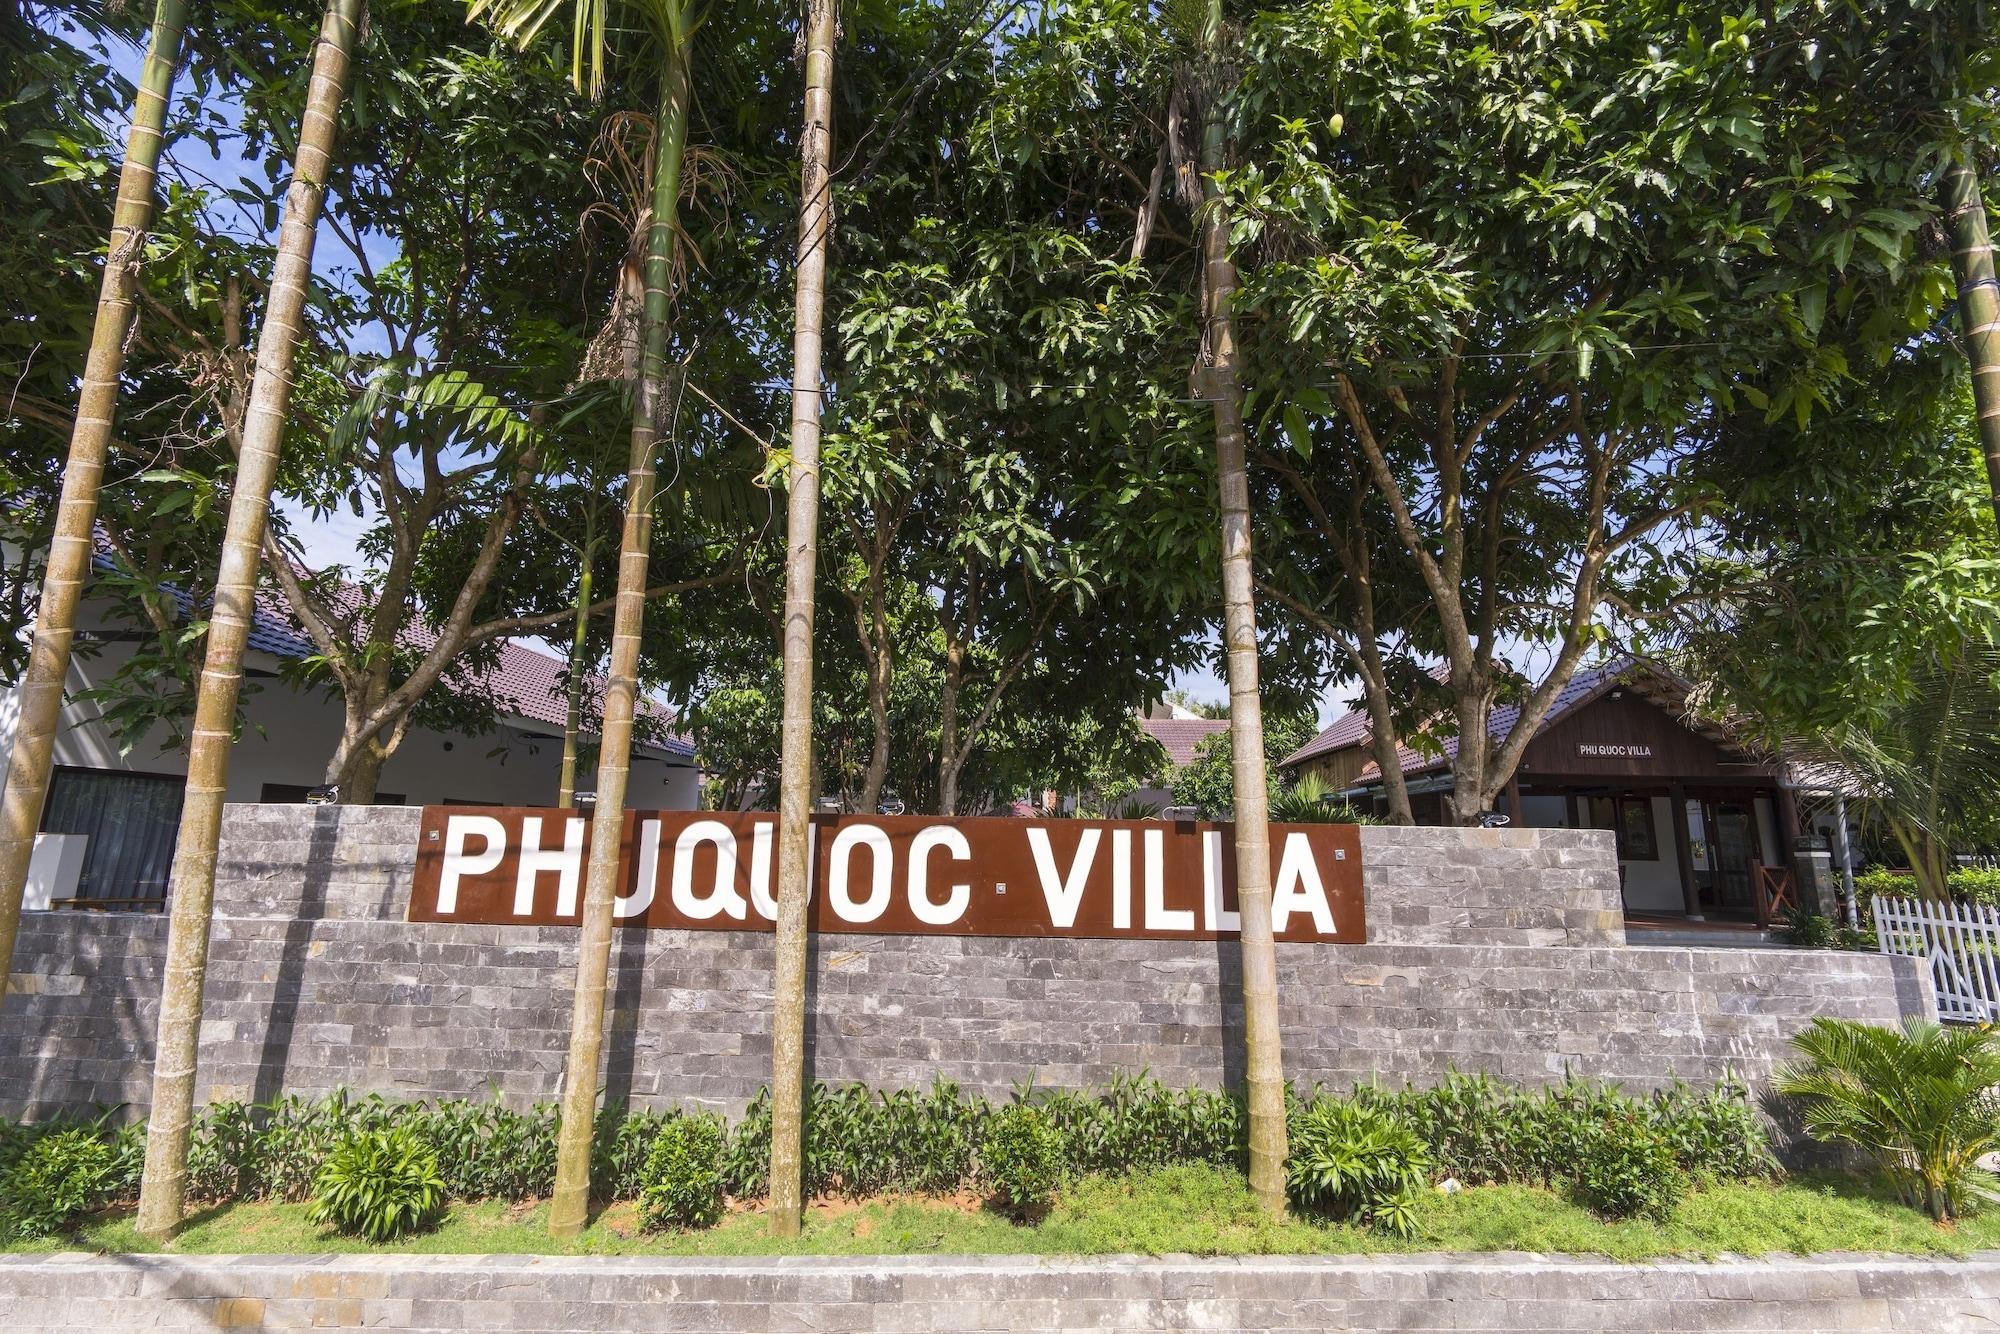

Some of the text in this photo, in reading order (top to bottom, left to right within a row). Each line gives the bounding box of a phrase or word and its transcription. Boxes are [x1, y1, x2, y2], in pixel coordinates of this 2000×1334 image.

[1580, 745, 1651, 756] PHU QUOC VILLA
[1026, 828, 1337, 934] VILLA
